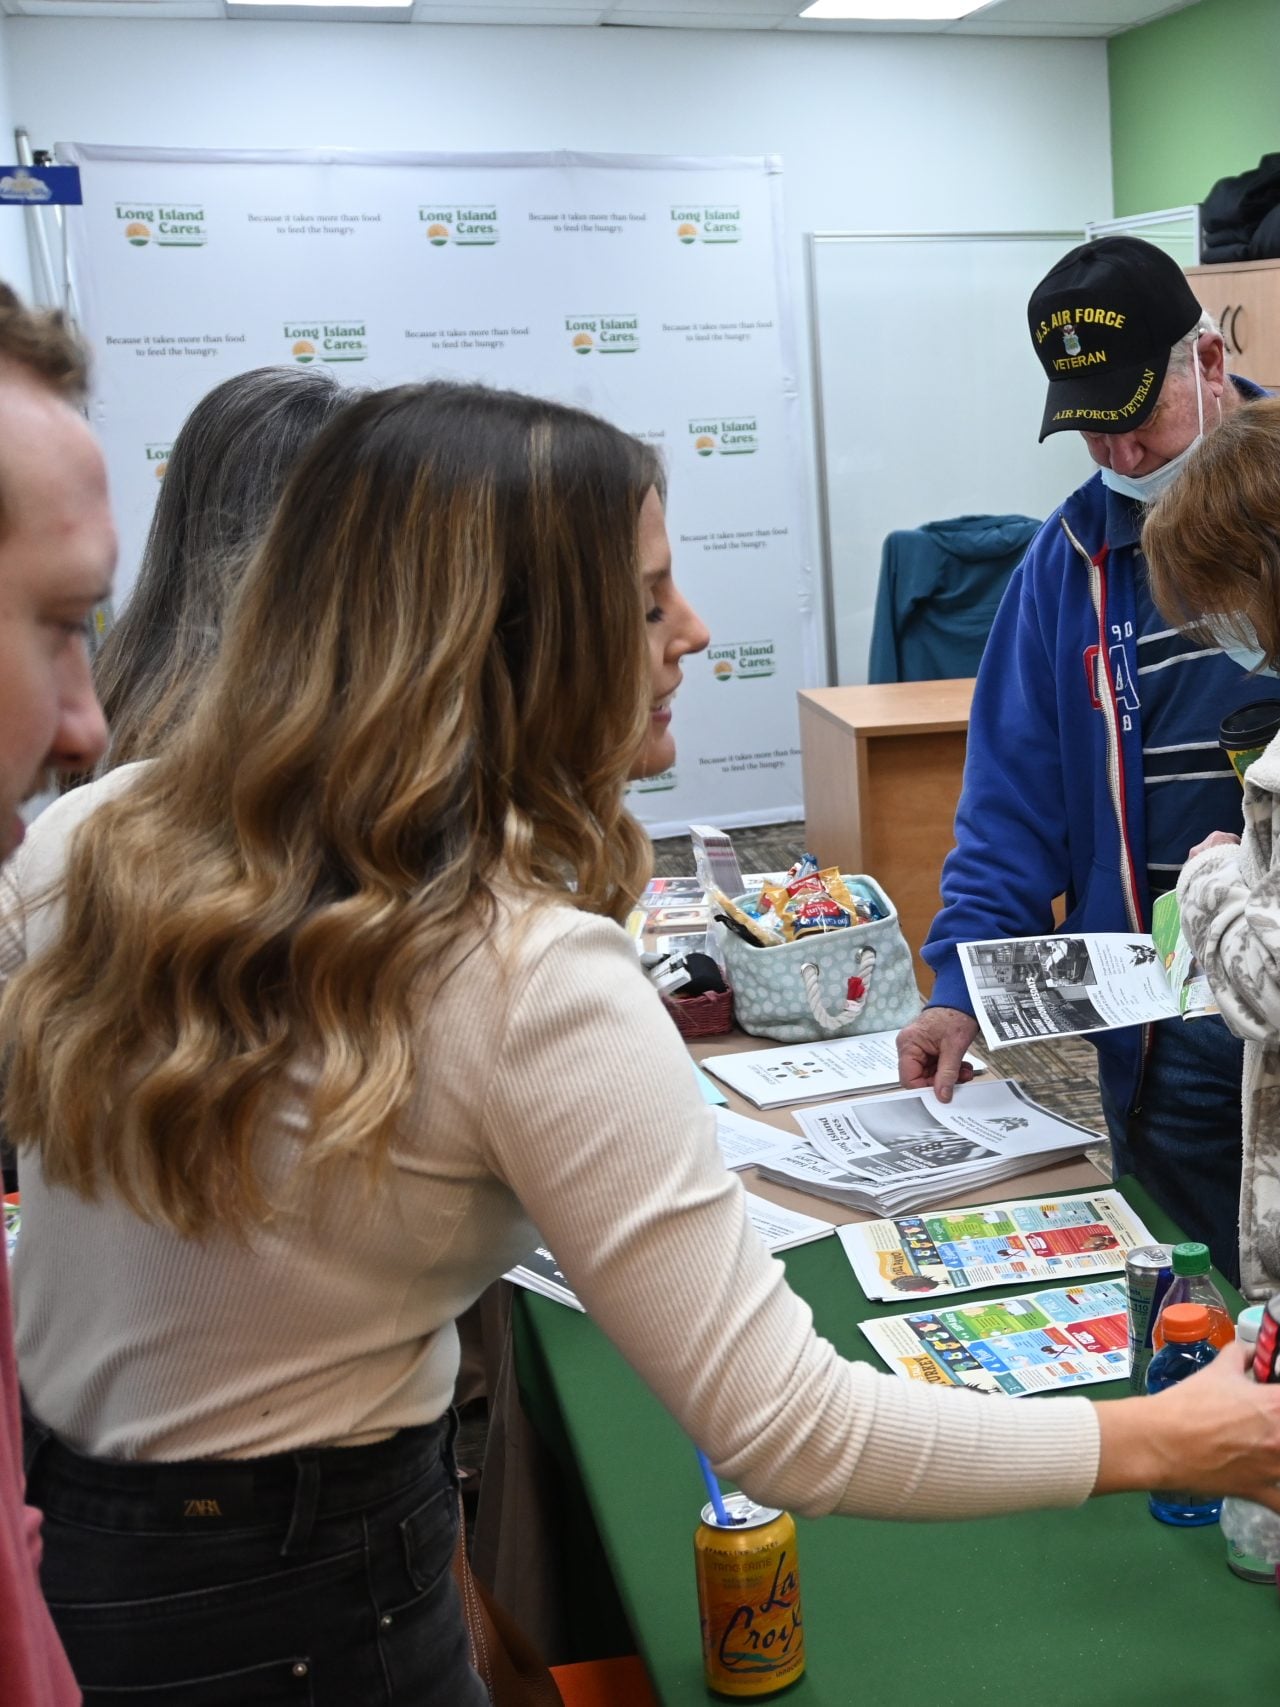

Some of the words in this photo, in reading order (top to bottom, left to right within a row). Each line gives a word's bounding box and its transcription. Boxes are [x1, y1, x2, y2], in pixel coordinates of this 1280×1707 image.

[116, 207, 154, 222] Long
[159, 208, 204, 221] Island
[419, 209, 452, 223] Long
[456, 209, 496, 221] Island
[671, 209, 701, 223] Long
[704, 209, 740, 220] Island
[159, 222, 202, 234] Cares
[456, 222, 493, 233] Cares
[704, 222, 737, 232] Cares
[284, 326, 319, 340] Long
[323, 325, 365, 337] Island
[565, 319, 597, 333] Long
[600, 319, 637, 330] Island
[1035, 320, 1050, 344] U.S.
[1051, 309, 1071, 329] AIR
[1075, 307, 1126, 329] FORCE
[600, 331, 634, 342] Cares
[323, 338, 362, 350] Cares
[1053, 350, 1107, 371] VETERAN
[1053, 409, 1075, 421] AIR
[1077, 409, 1119, 421] FORCE
[1119, 368, 1156, 418] VETERAN
[688, 422, 718, 435] Long
[721, 421, 757, 433] Island
[721, 433, 754, 444] Cares
[707, 649, 736, 660] Long
[739, 644, 774, 657] Island
[739, 657, 771, 669] Cares
[817, 1117, 840, 1143] Island
[831, 1118, 850, 1141] Cares
[837, 1140, 855, 1156] Long
[184, 1499, 222, 1517] ZARA
